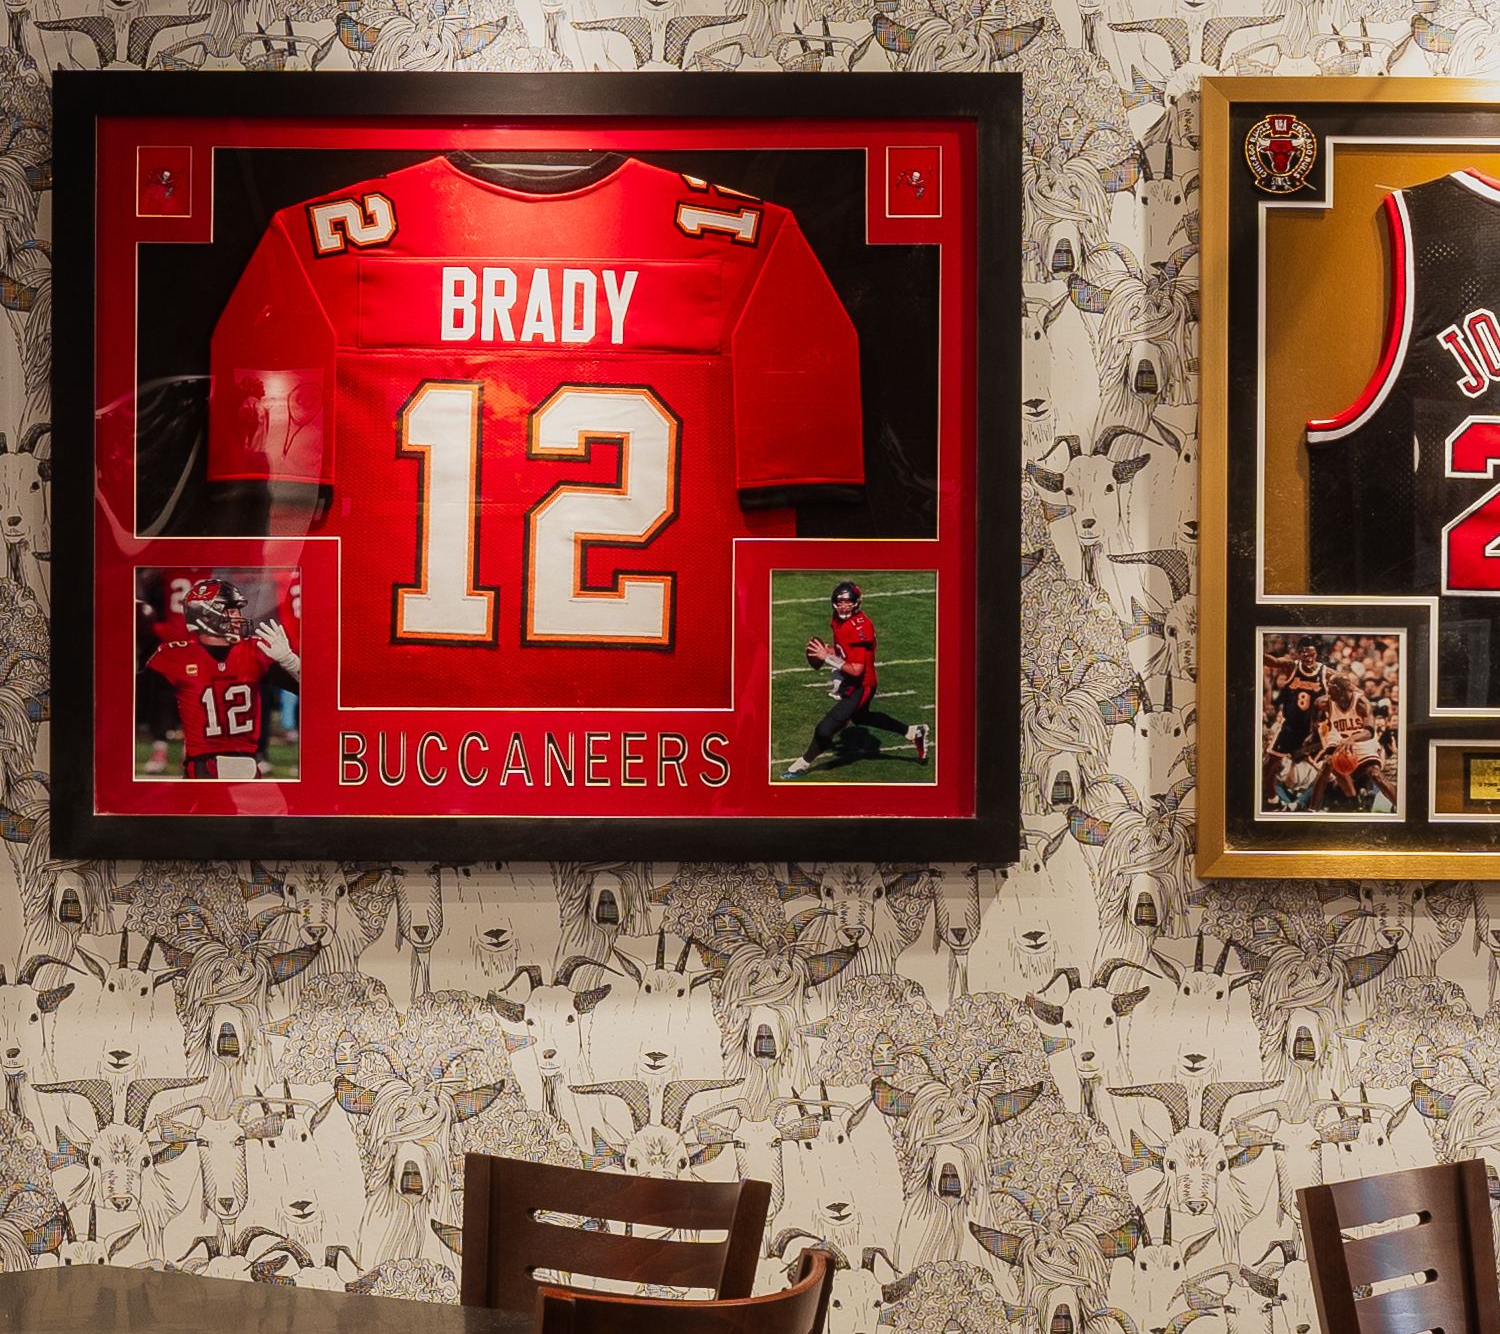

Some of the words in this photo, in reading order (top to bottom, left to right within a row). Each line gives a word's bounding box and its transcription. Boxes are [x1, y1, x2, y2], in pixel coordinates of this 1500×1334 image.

[440, 266, 639, 344] BRADY
[389, 377, 683, 652] 12
[202, 684, 254, 737] 12
[1297, 692, 1310, 711] 8
[338, 731, 731, 787] BUCCANEERS
